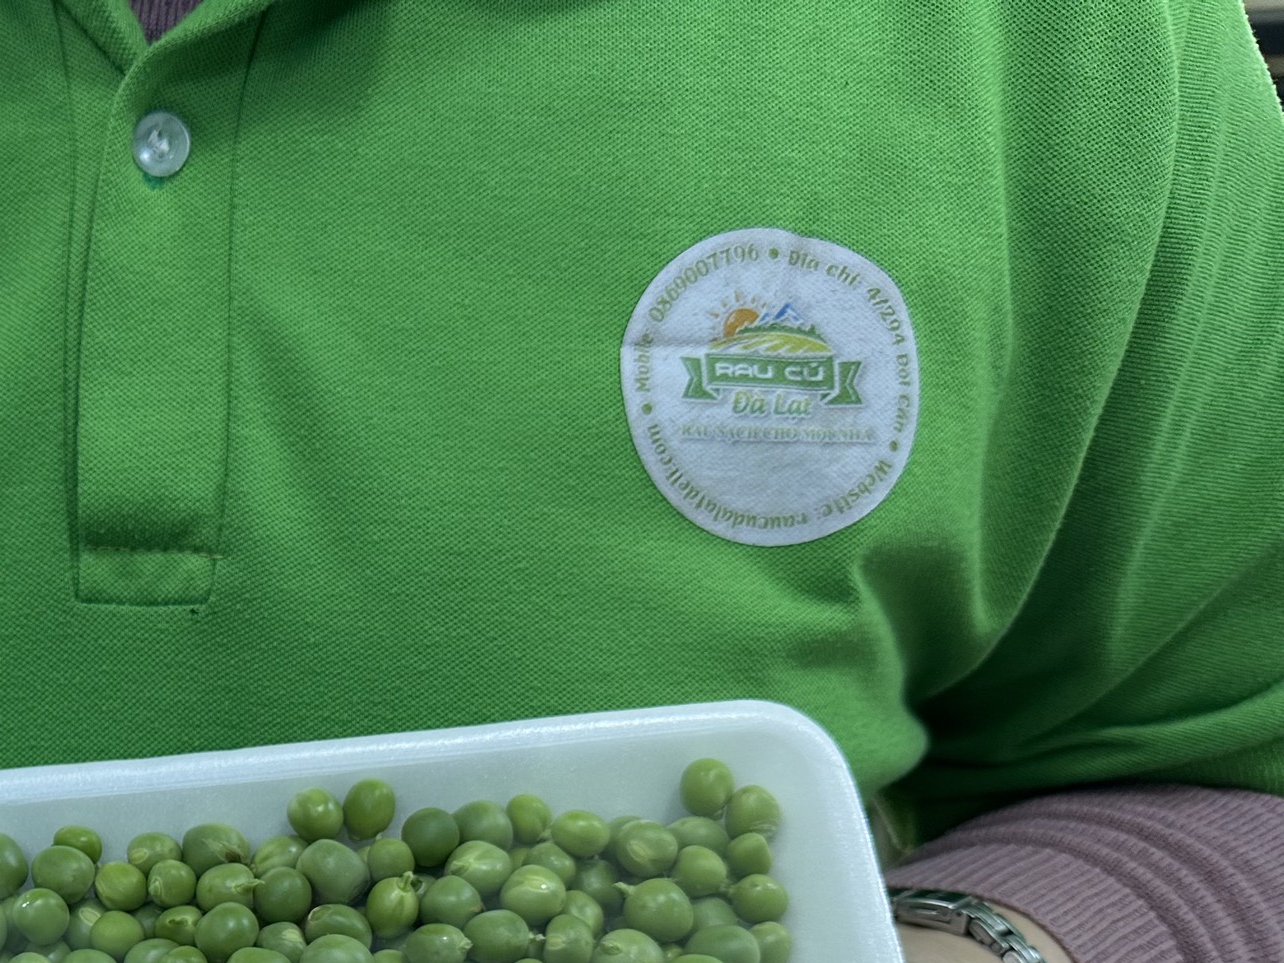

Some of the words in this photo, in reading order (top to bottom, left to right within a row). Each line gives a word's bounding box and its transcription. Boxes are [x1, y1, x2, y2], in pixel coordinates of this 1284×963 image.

[648, 243, 759, 322] 0869007796
[866, 286, 906, 345] 4/294
[714, 362, 774, 379] RAU
